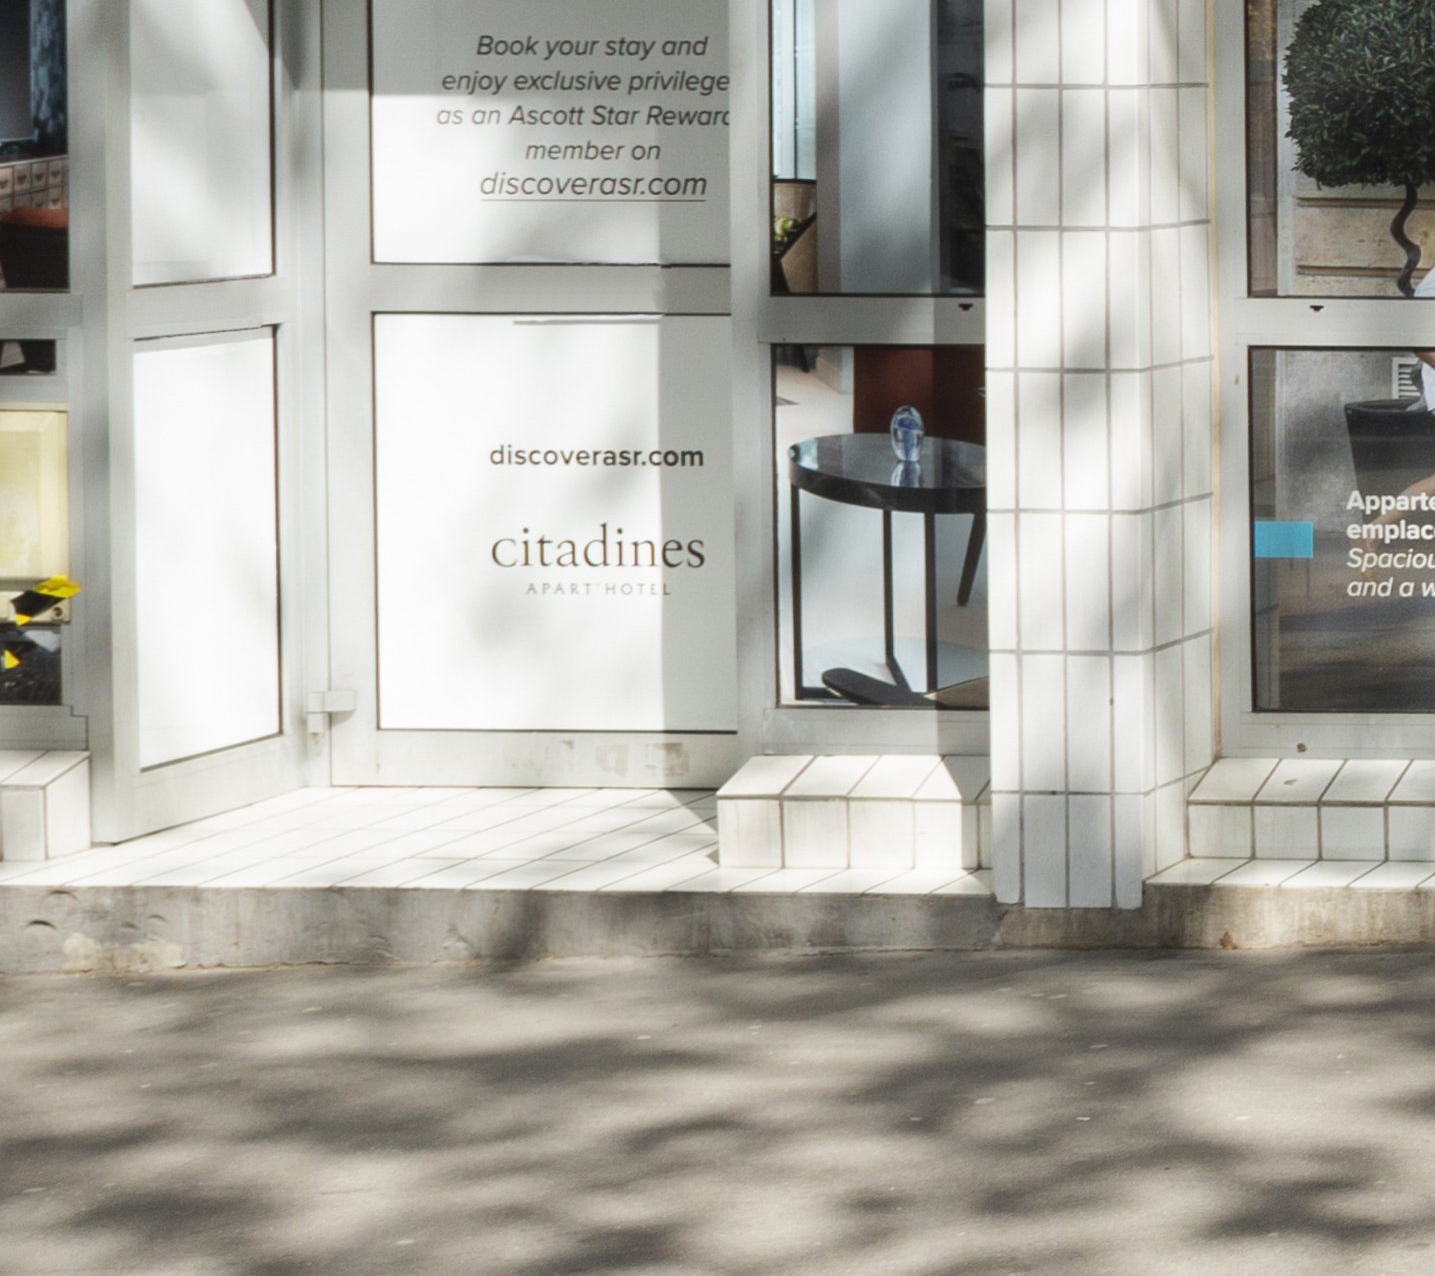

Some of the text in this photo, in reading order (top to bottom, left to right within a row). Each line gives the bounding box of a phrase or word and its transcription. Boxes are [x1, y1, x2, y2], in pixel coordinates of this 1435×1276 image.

[476, 35, 708, 61] Book your stay and
[442, 71, 507, 95] enjoy
[514, 71, 621, 91] exclusive
[437, 109, 463, 125] as
[471, 109, 501, 125] an
[508, 105, 584, 125] Ascott
[591, 105, 640, 125] Star
[525, 140, 661, 160] member on
[480, 171, 707, 195] discoverasr.com
[490, 444, 704, 467] discoverasr.com
[491, 521, 706, 569] citadines
[526, 582, 671, 596] APART'HOTEL
[1347, 577, 1394, 597] and
[1399, 582, 1414, 597] a
